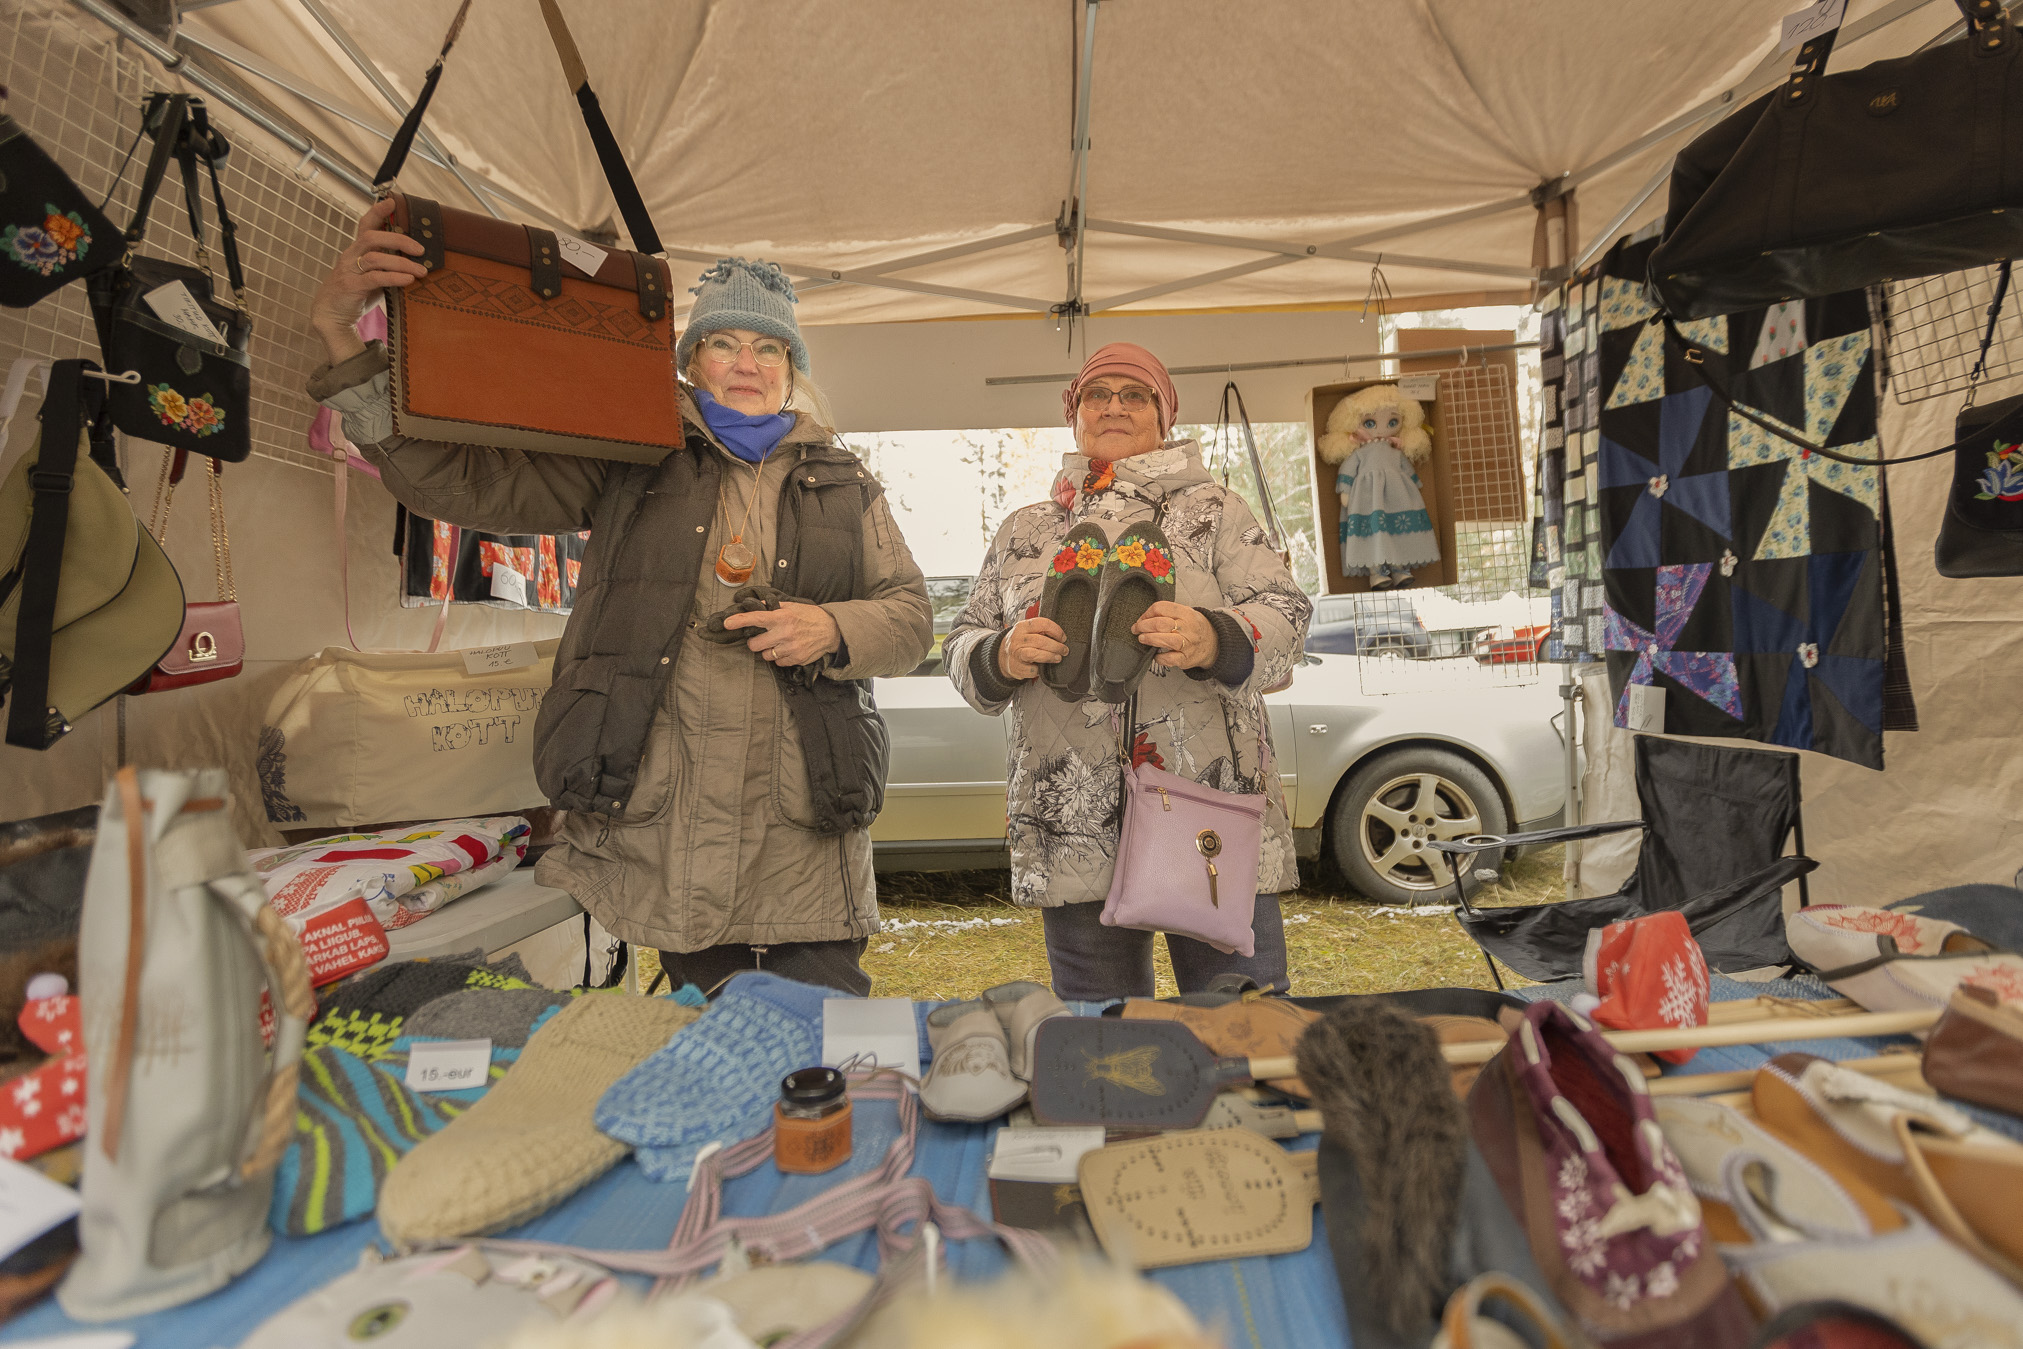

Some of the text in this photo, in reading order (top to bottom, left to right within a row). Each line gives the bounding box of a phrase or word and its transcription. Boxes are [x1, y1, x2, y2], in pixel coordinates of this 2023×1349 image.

[431, 715, 521, 752] KOTT
[304, 922, 347, 943] AKNAL
[314, 953, 358, 975] VAHEL
